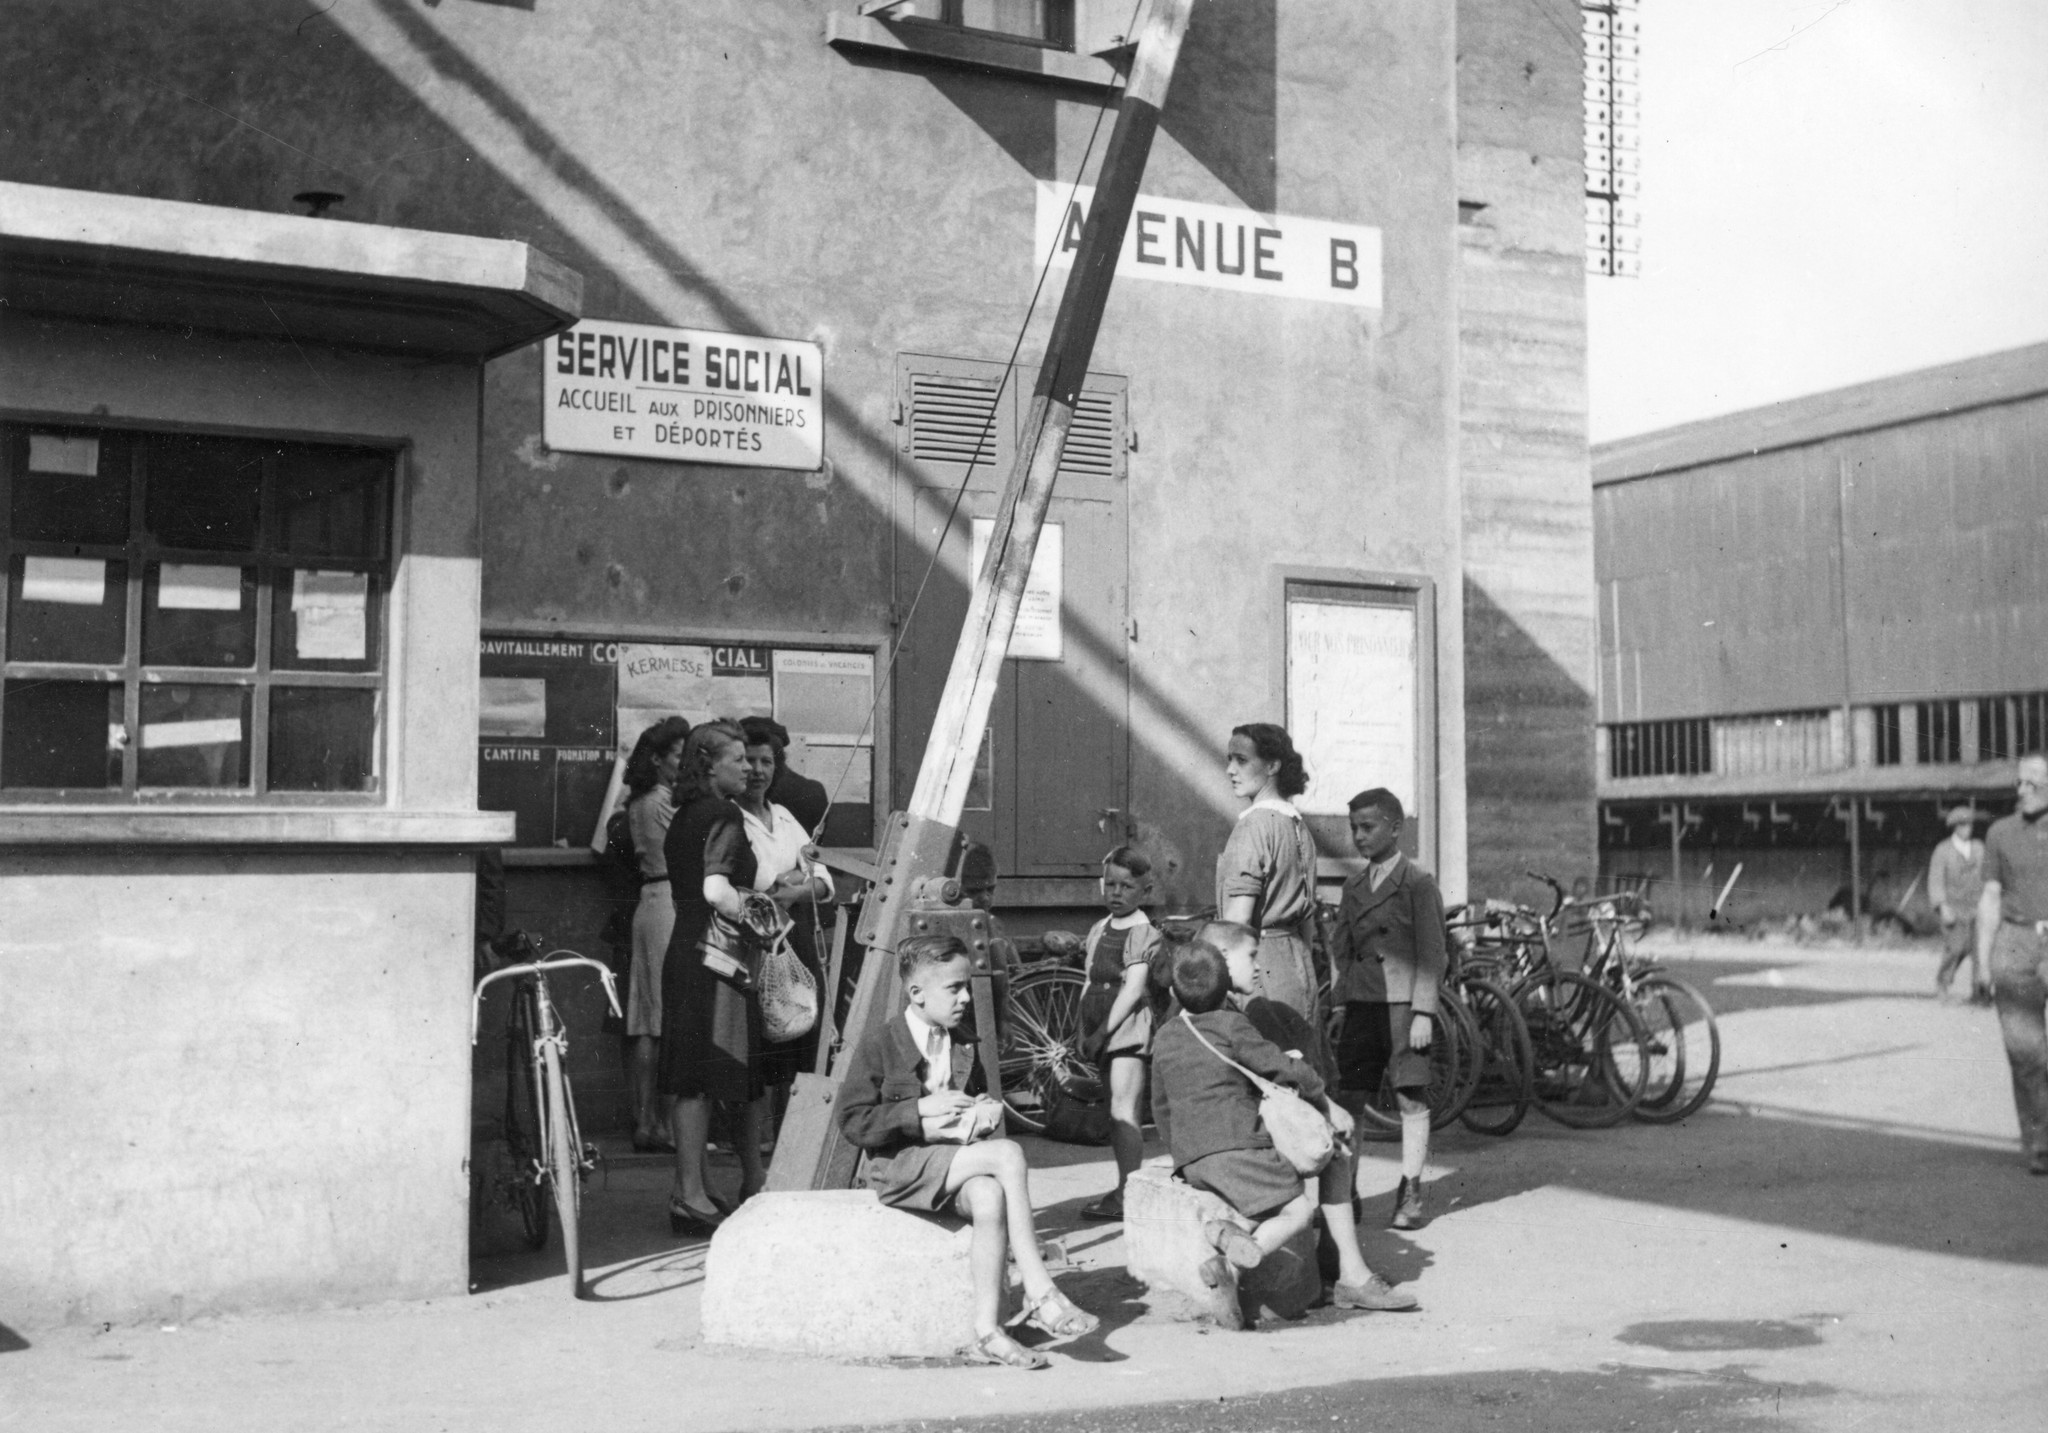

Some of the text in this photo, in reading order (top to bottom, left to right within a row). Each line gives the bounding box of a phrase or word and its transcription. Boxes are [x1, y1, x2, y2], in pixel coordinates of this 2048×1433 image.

[1061, 200, 1359, 290] AENUE B
[557, 331, 811, 397] SERVICE SOCIAL
[558, 388, 806, 428] ACCUEIL AUX PRISONNIERS
[613, 421, 763, 451] ET DÉPORTÉS
[626, 657, 705, 678] KERMESSE
[484, 748, 540, 760] CANTINE
